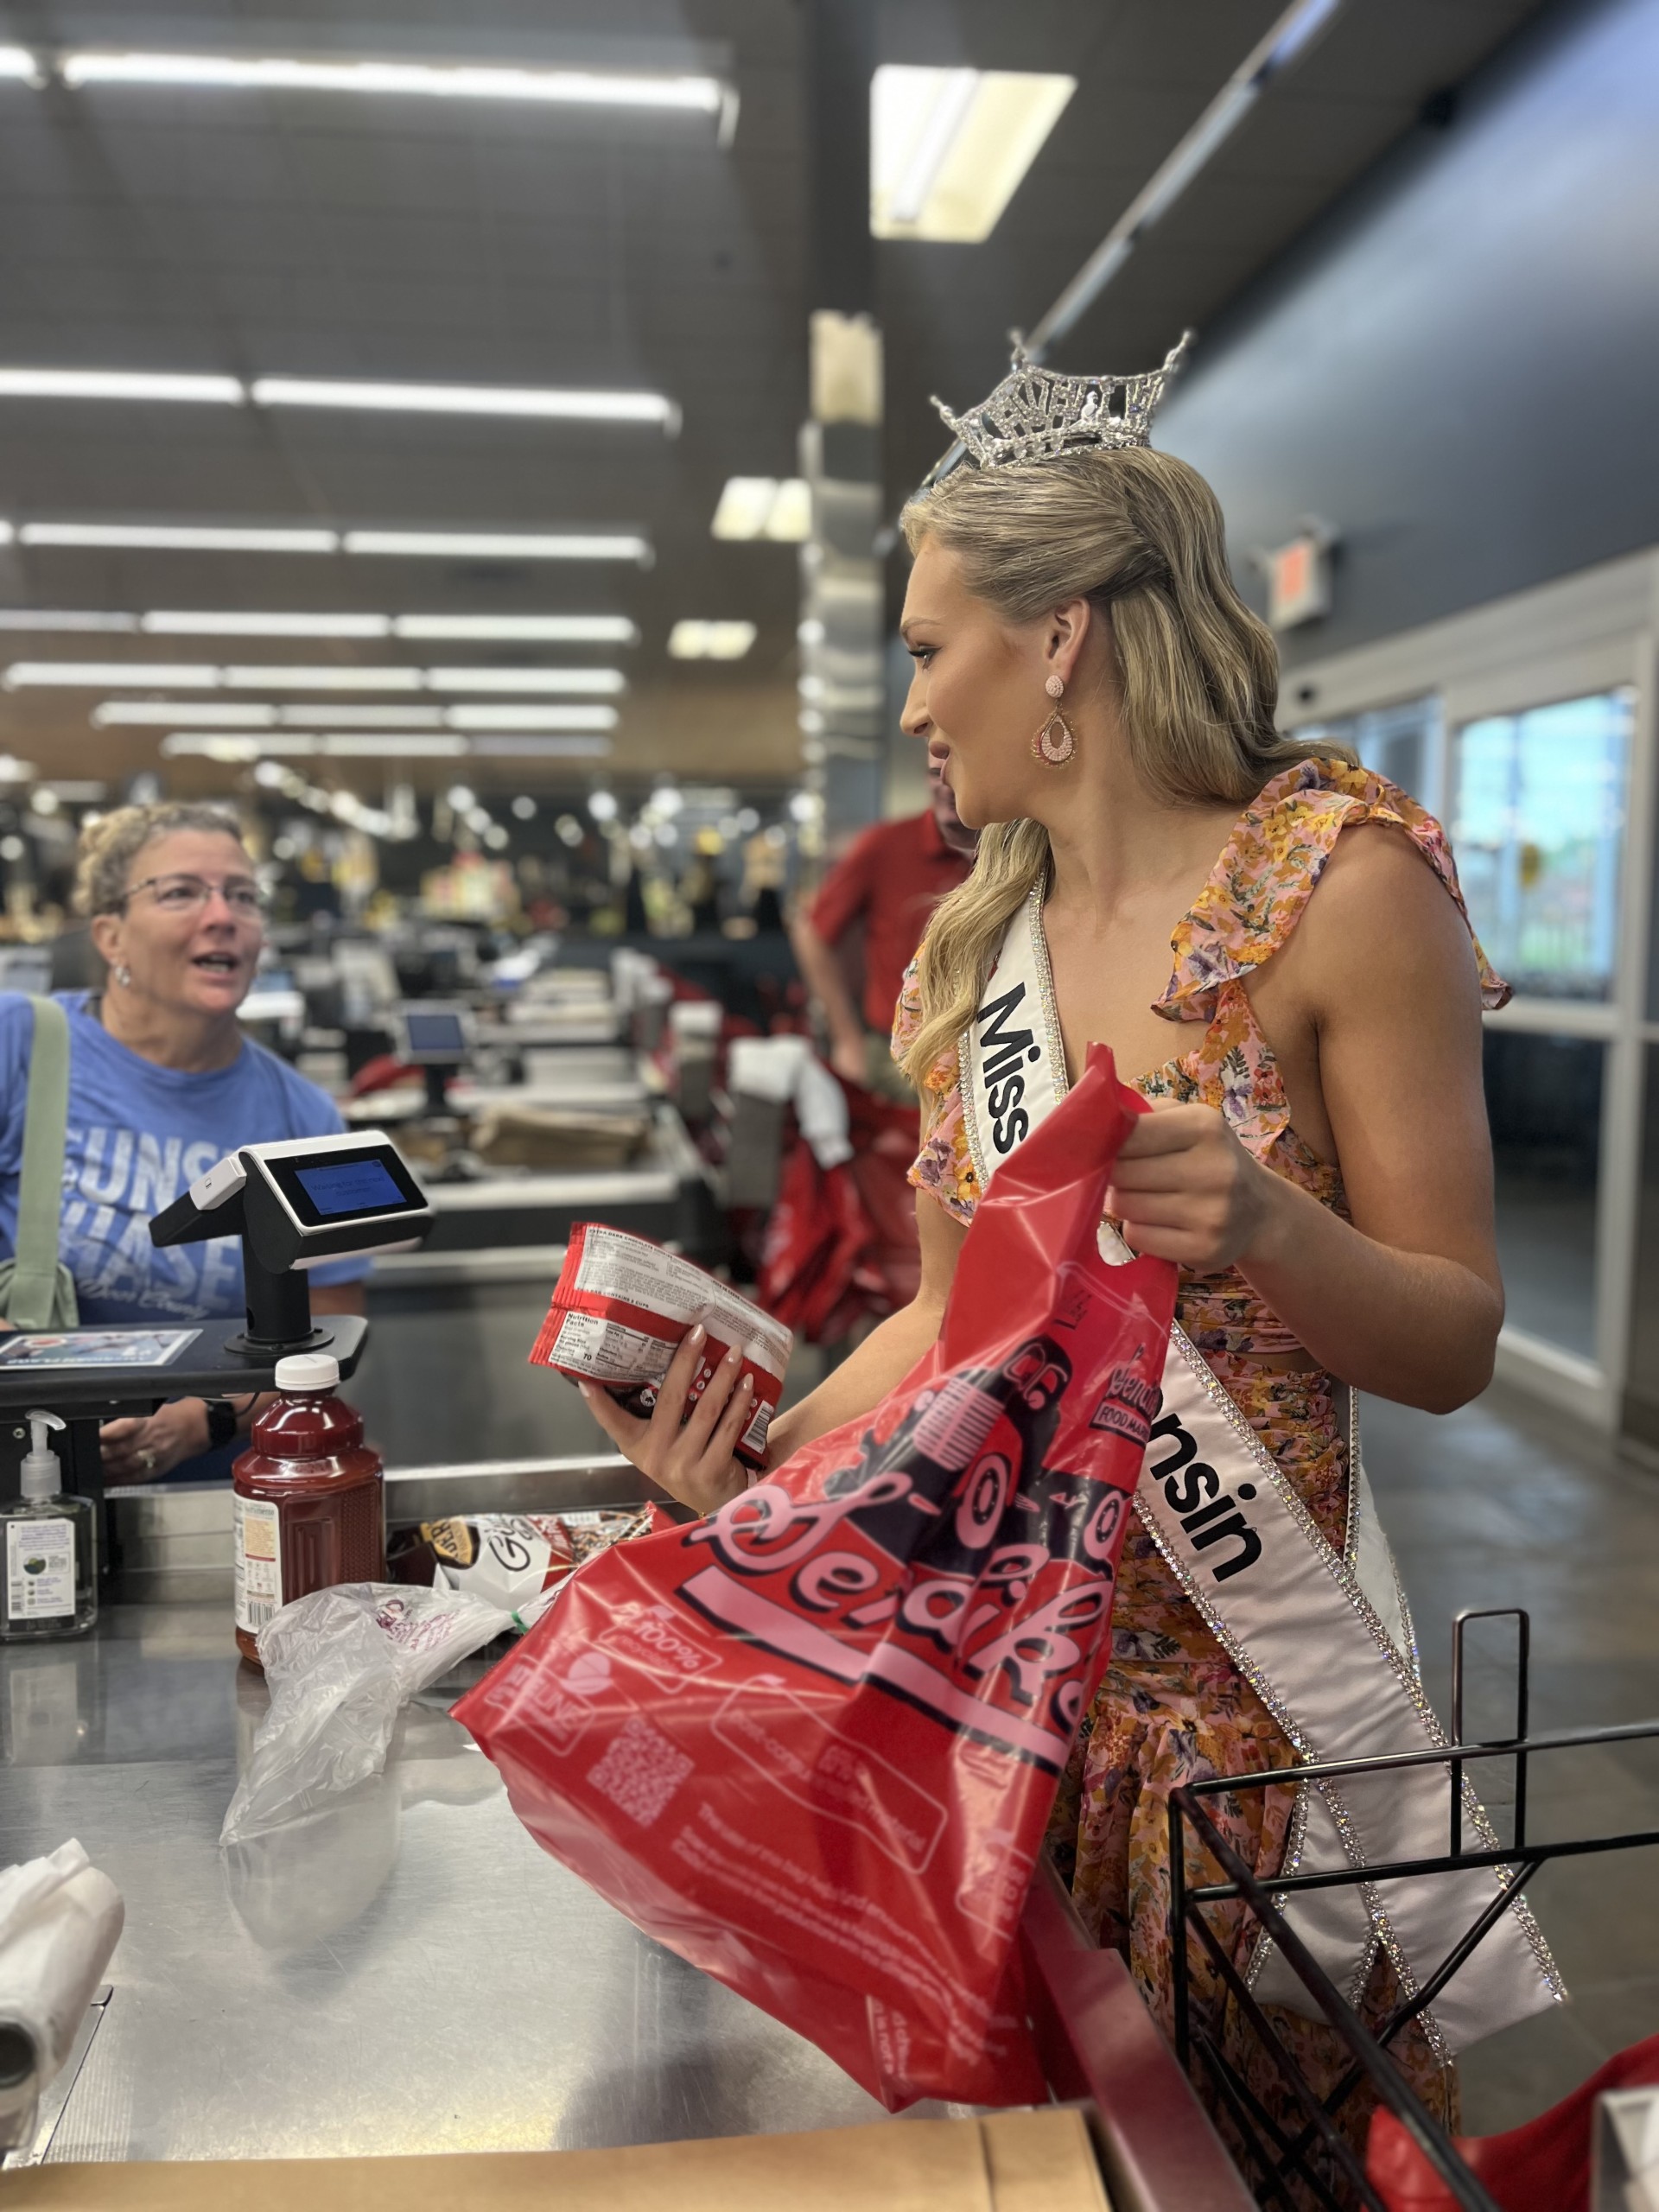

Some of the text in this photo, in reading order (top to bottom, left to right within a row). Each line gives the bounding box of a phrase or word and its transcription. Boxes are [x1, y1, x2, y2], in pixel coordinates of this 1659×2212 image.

[976, 981, 1041, 1154] Miss
[565, 1319, 585, 1328] Facts
[567, 1313, 599, 1325] Nutrition
[583, 1352, 592, 1361] 70
[1098, 1405, 1128, 1427] FOOD
[632, 1619, 702, 1669] 100%
